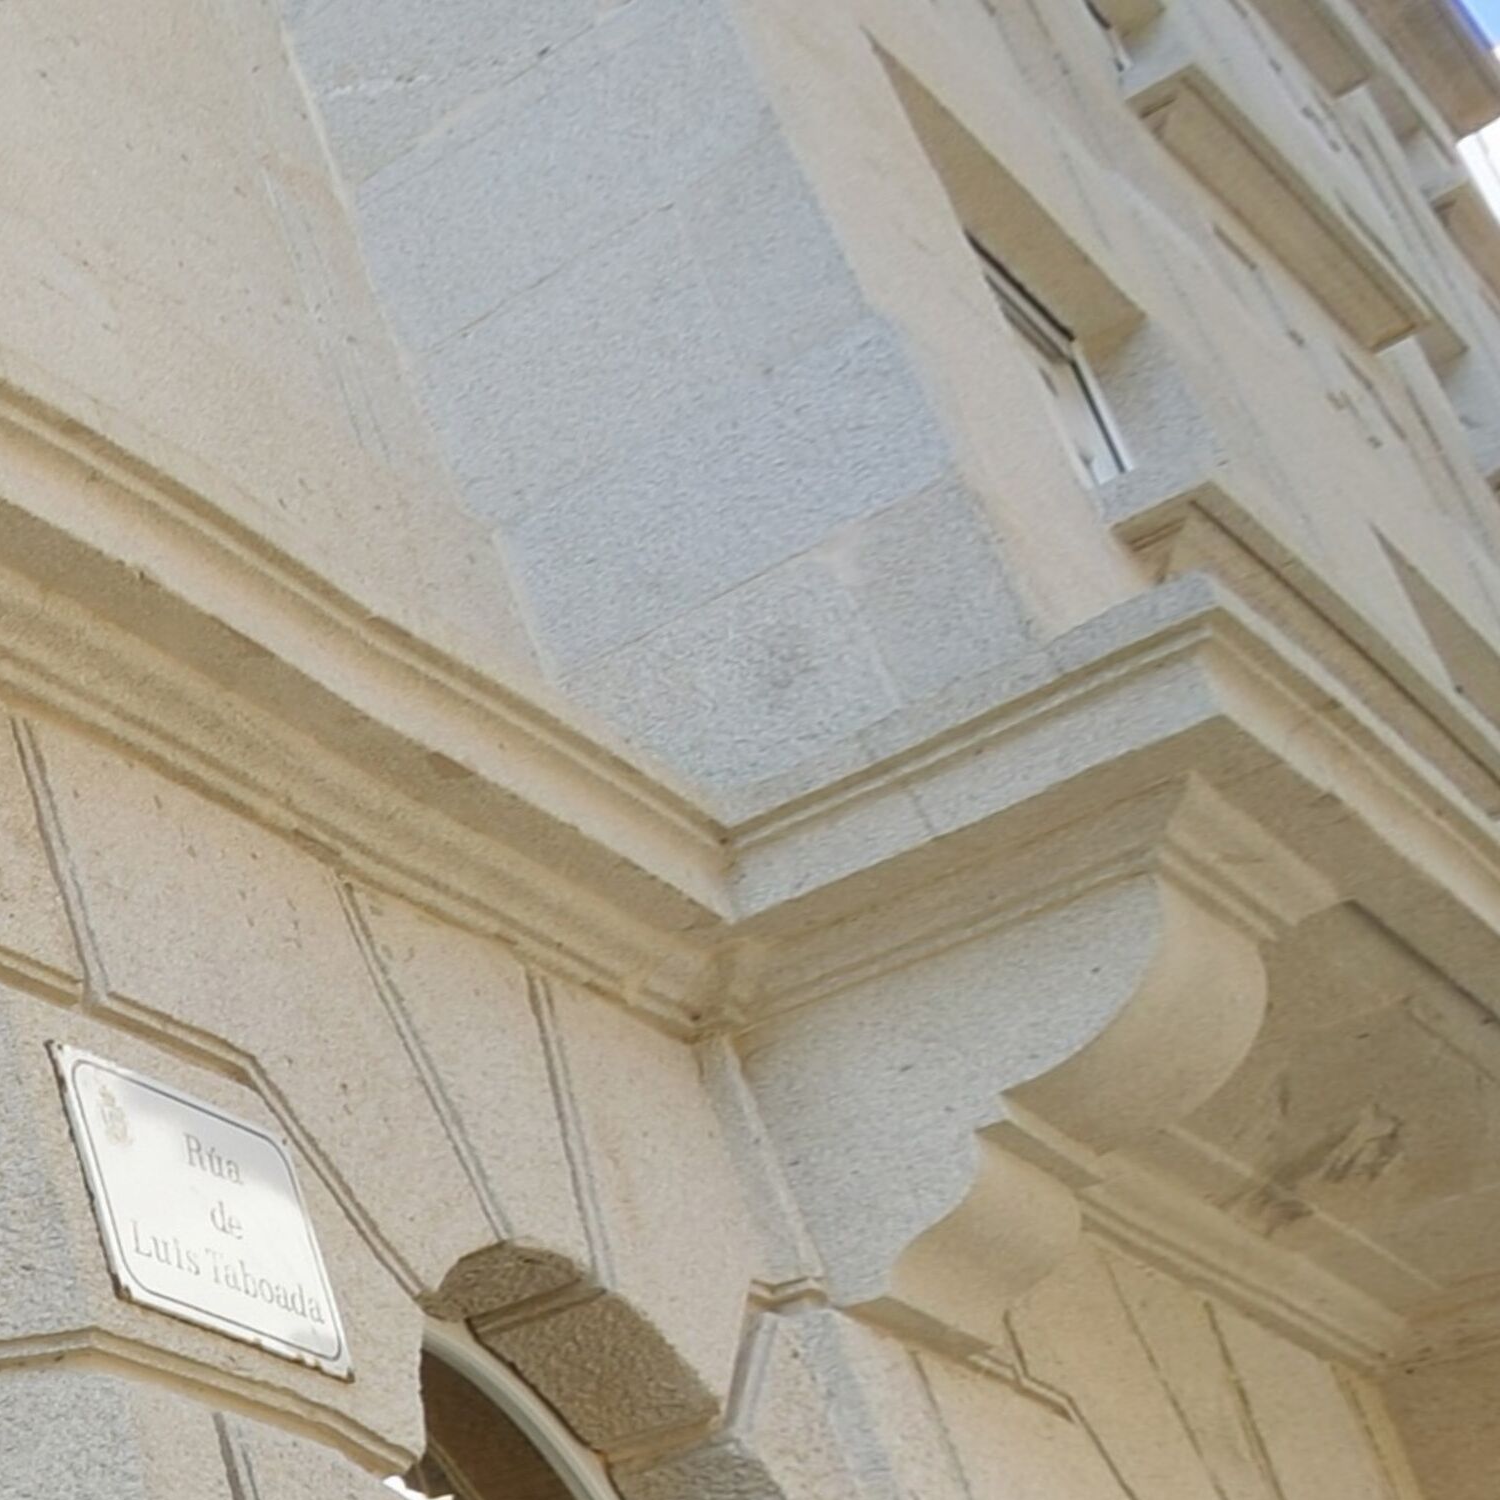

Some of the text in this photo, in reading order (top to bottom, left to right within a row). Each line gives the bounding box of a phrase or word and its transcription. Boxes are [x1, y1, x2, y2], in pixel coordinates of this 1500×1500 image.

[182, 1132, 245, 1187] Rúa
[209, 1199, 244, 1241] de
[130, 1219, 326, 1326] Luis Taboada
